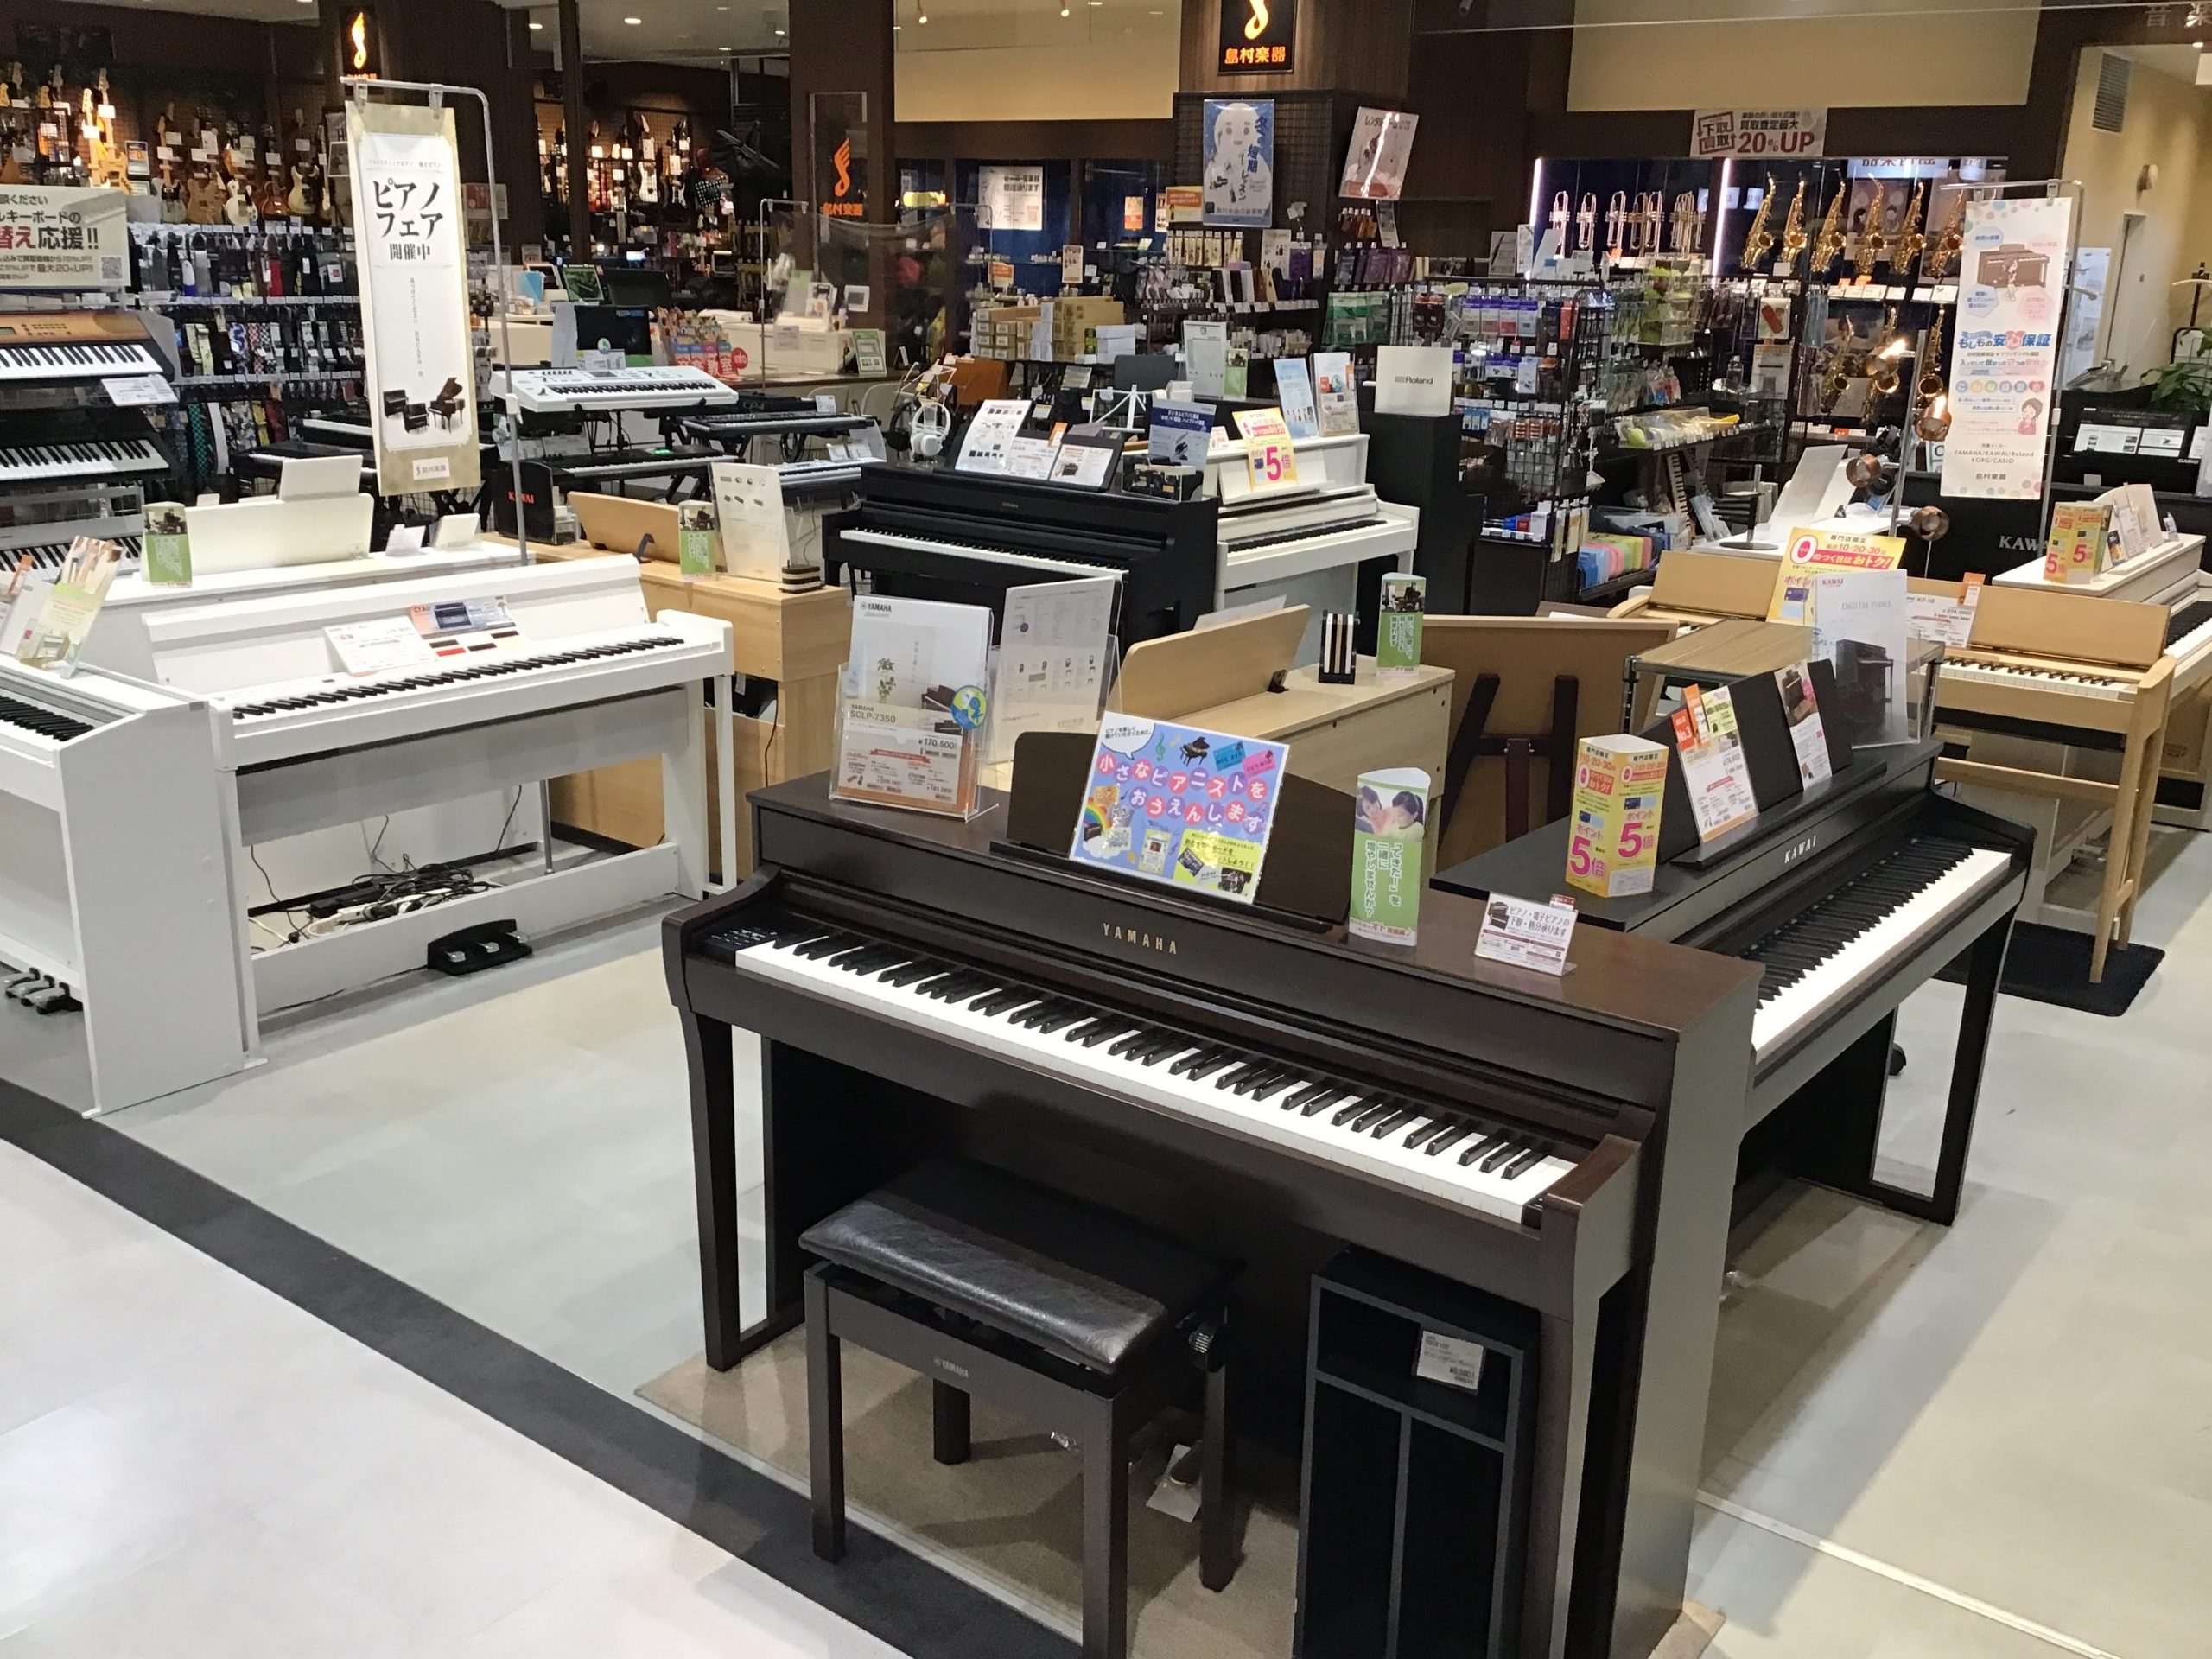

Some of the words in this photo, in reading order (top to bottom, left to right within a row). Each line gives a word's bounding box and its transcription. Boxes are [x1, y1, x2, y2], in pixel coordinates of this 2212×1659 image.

[1225, 47, 1286, 64] 島村楽器
[1738, 131, 1815, 153] 20%UP
[372, 177, 440, 210] ピアノ
[376, 212, 443, 239] フェア
[389, 243, 430, 260] 開催中
[1406, 376, 1433, 385] Roland
[1266, 446, 1281, 481] 5
[1830, 535, 1866, 543] 専門店限定
[2045, 553, 2058, 574] 5
[2074, 544, 2087, 563] 5
[868, 603, 892, 613] YAMAHA
[1842, 601, 1868, 610] DIGITAL
[1872, 601, 1891, 609] PIANO
[849, 709, 896, 723] SCLP-7350
[1676, 727, 1692, 743] No.3
[1099, 754, 1264, 798] 小さなピアニストを
[1131, 789, 1262, 832] おうえんします
[1627, 810, 1653, 821] ポイント
[1618, 823, 1642, 857] 5
[1784, 835, 1816, 864] KAWAI
[1570, 836, 1591, 875] 5
[1592, 857, 1606, 877] 倍
[1510, 906, 1570, 926] ピアノ・電子ピアノの
[1510, 917, 1567, 938] 下取・処分承ります
[1103, 922, 1177, 955] YAMAHA
[942, 1359, 969, 1378] YAMAHA
